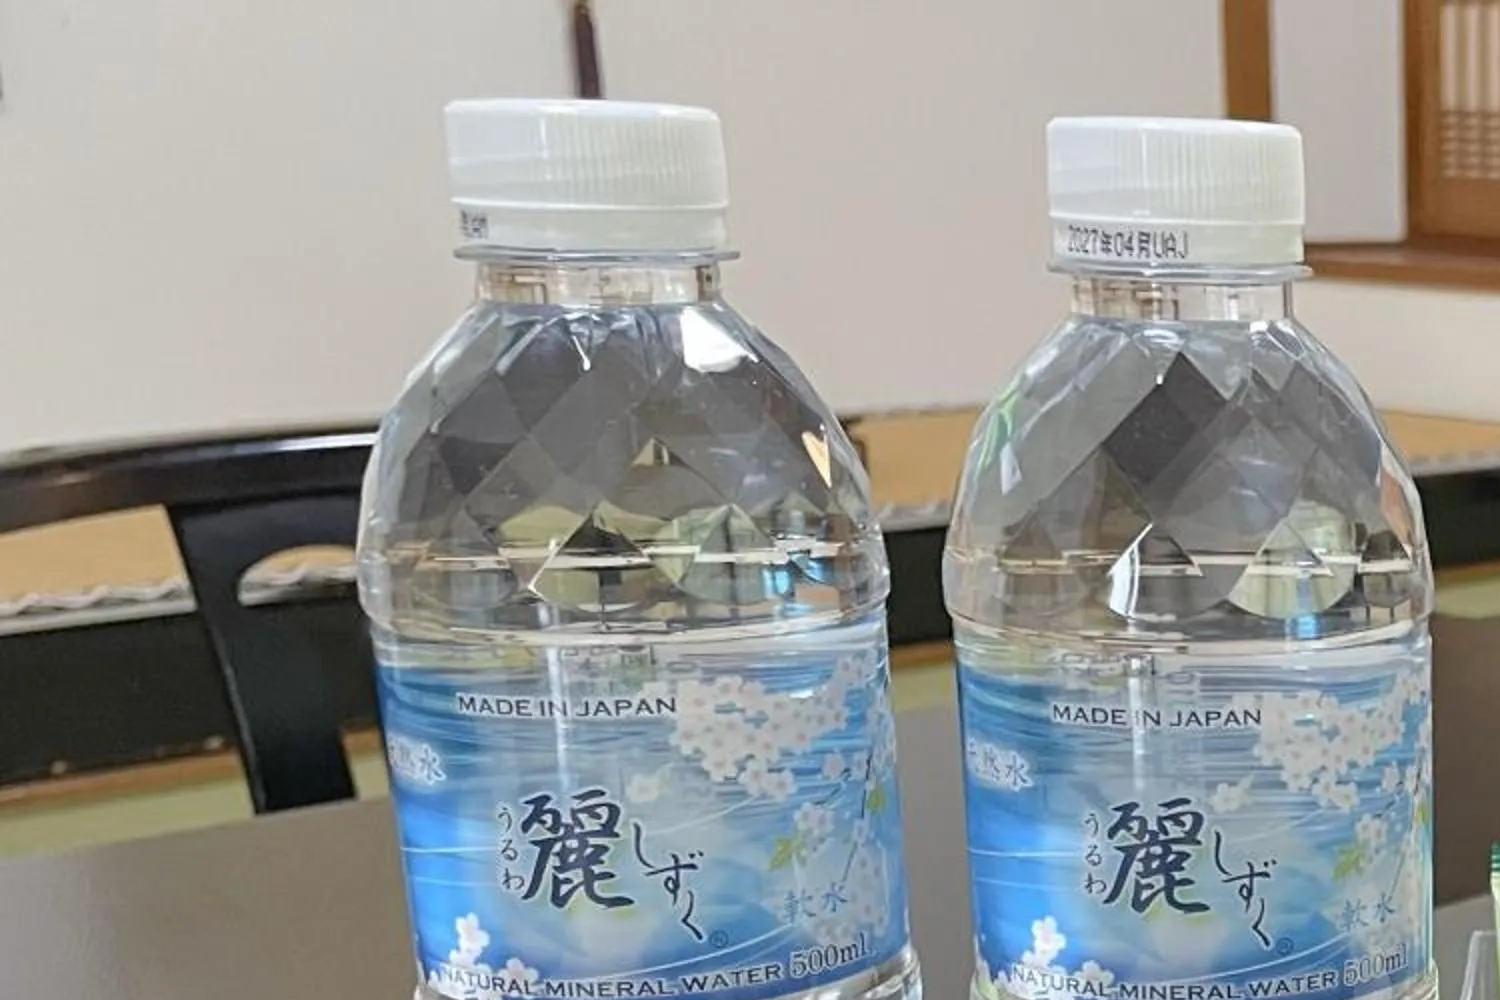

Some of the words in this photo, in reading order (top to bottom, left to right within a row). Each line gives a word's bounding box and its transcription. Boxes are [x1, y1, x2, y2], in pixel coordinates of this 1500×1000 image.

[457, 696, 533, 717] MADE
[540, 700, 568, 718] IN
[576, 697, 677, 718] JAPAN
[1053, 704, 1127, 725] MADE
[1135, 709, 1161, 727] IN
[1170, 709, 1262, 727] JAPAN
[498, 806, 525, 890] うるわ
[1085, 812, 1107, 894] うるわ
[446, 963, 541, 995] NATURAL
[545, 979, 674, 997] MINERAL
[681, 963, 781, 991] WATER
[792, 931, 866, 976] 500ml
[1012, 962, 1114, 997] NATURAL
[1118, 983, 1241, 1000] MINERAL
[1249, 970, 1336, 997] WATER
[1345, 943, 1407, 985] 500ml
